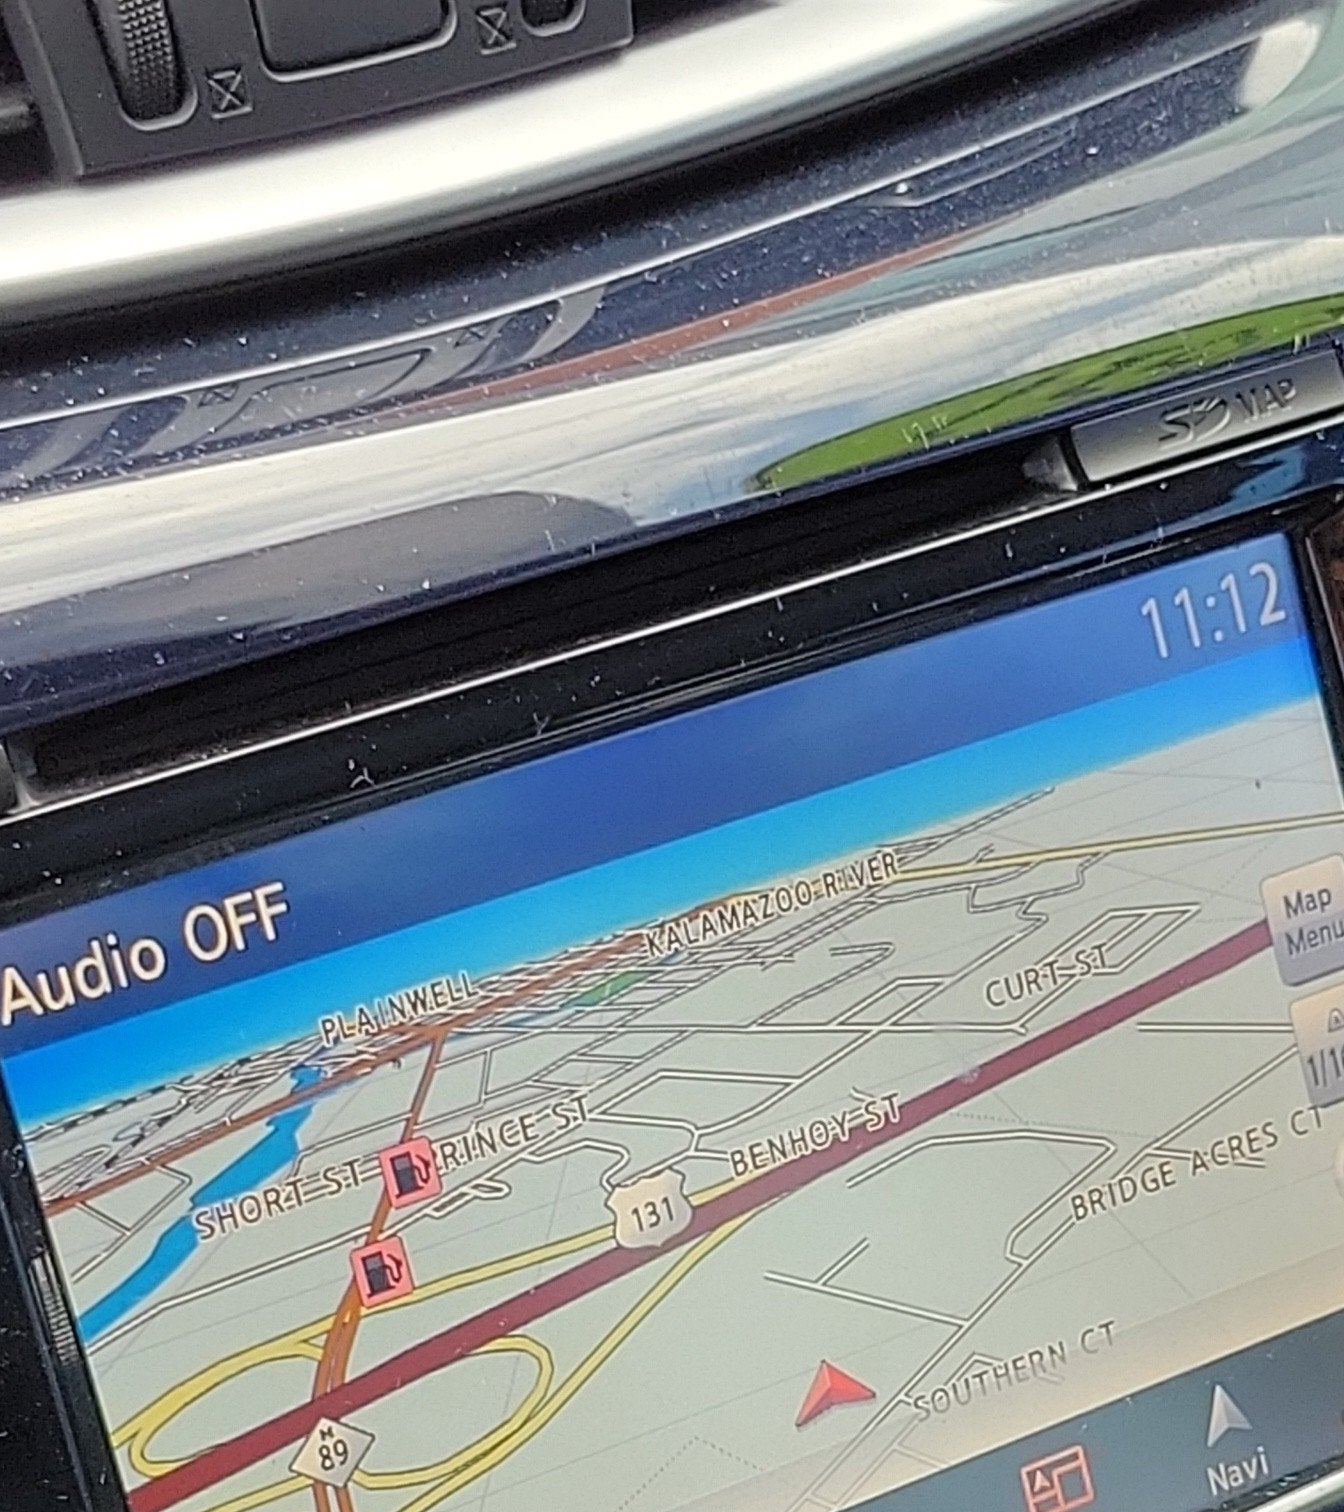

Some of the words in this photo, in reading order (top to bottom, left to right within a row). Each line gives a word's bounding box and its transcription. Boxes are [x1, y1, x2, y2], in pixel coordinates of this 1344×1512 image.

[1141, 561, 1287, 660] 11:12
[645, 879, 814, 957] KALAMAZOO
[823, 851, 900, 899] RIVER
[1282, 886, 1333, 920] Map
[0, 934, 166, 1027] Audio
[182, 882, 290, 963] OFF
[984, 960, 1062, 1008] CURT
[1076, 943, 1109, 977] ST
[320, 973, 480, 1045] PLAINWELL
[552, 1094, 588, 1130] ST
[729, 1112, 852, 1178] BENHOY
[863, 1095, 903, 1133] ST
[194, 1178, 307, 1240] SHORT
[323, 1159, 361, 1197] ST
[1070, 1160, 1178, 1222] BRIDGE
[1190, 1119, 1279, 1177] ACRES
[1290, 1104, 1324, 1137] CT
[630, 1197, 675, 1234] 131
[913, 1340, 1067, 1422] SOUTHERN
[1080, 1320, 1117, 1355] CT
[318, 1438, 349, 1471] 89
[1206, 1446, 1271, 1497] Navi
